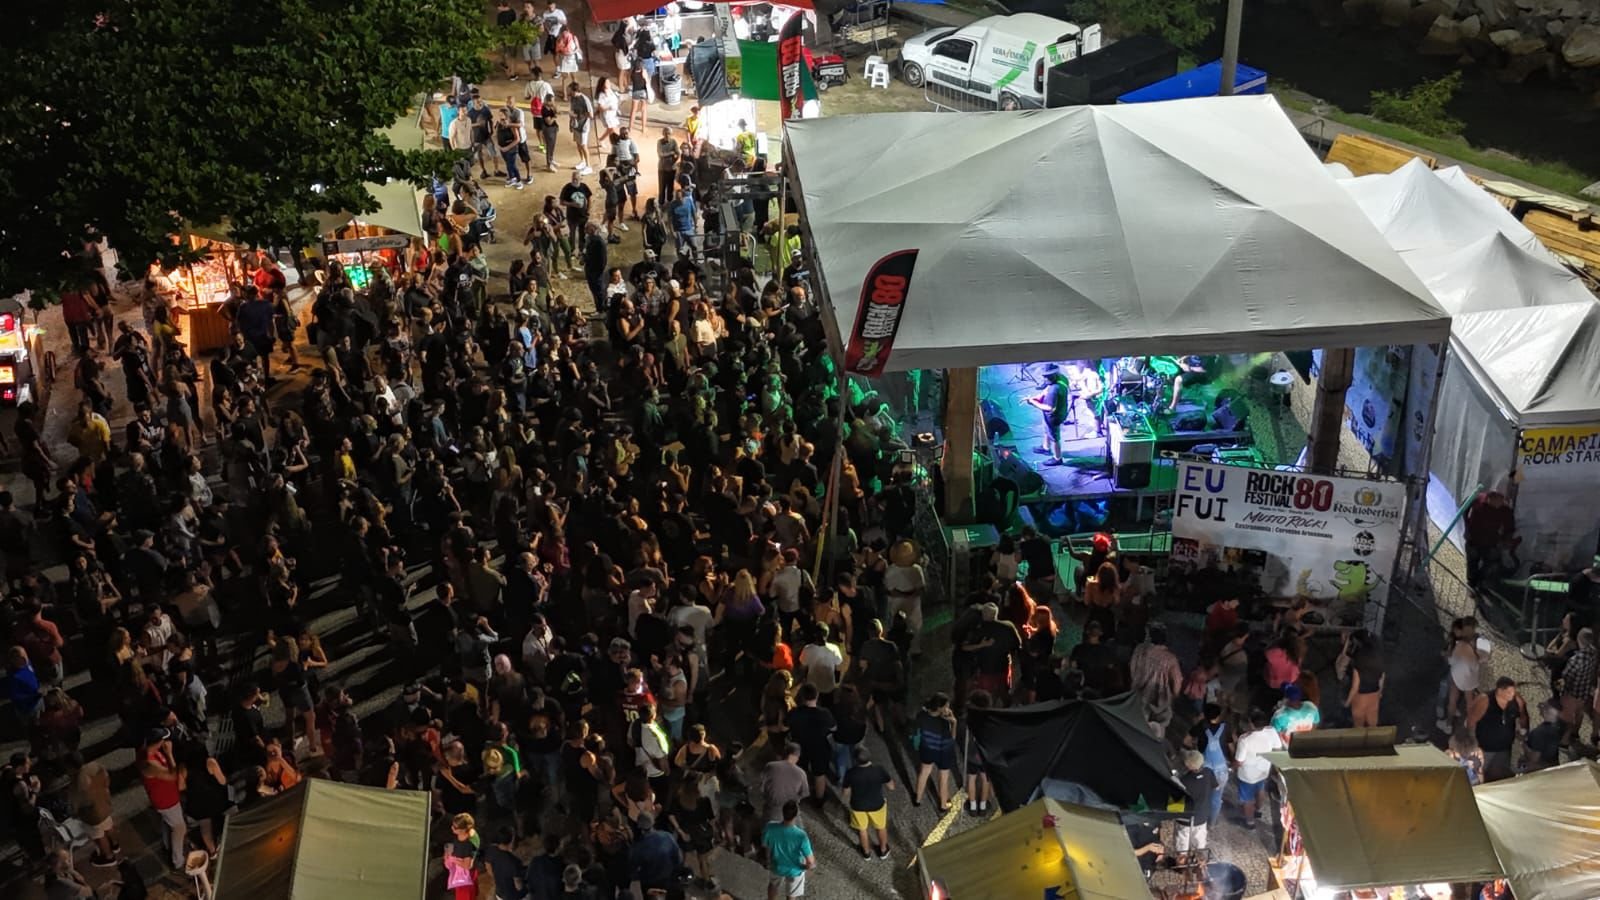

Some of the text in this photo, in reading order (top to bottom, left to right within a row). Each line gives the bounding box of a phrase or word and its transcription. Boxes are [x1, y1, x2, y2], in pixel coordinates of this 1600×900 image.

[862, 274, 907, 338] ROCK 80
[1522, 433, 1600, 452] CAMARI
[1523, 450, 1600, 465] ROCK STAR
[1184, 465, 1226, 493] EU
[1246, 471, 1335, 513] ROCK 80
[1176, 494, 1228, 522] FUI
[1244, 491, 1293, 509] FESTIVAL
